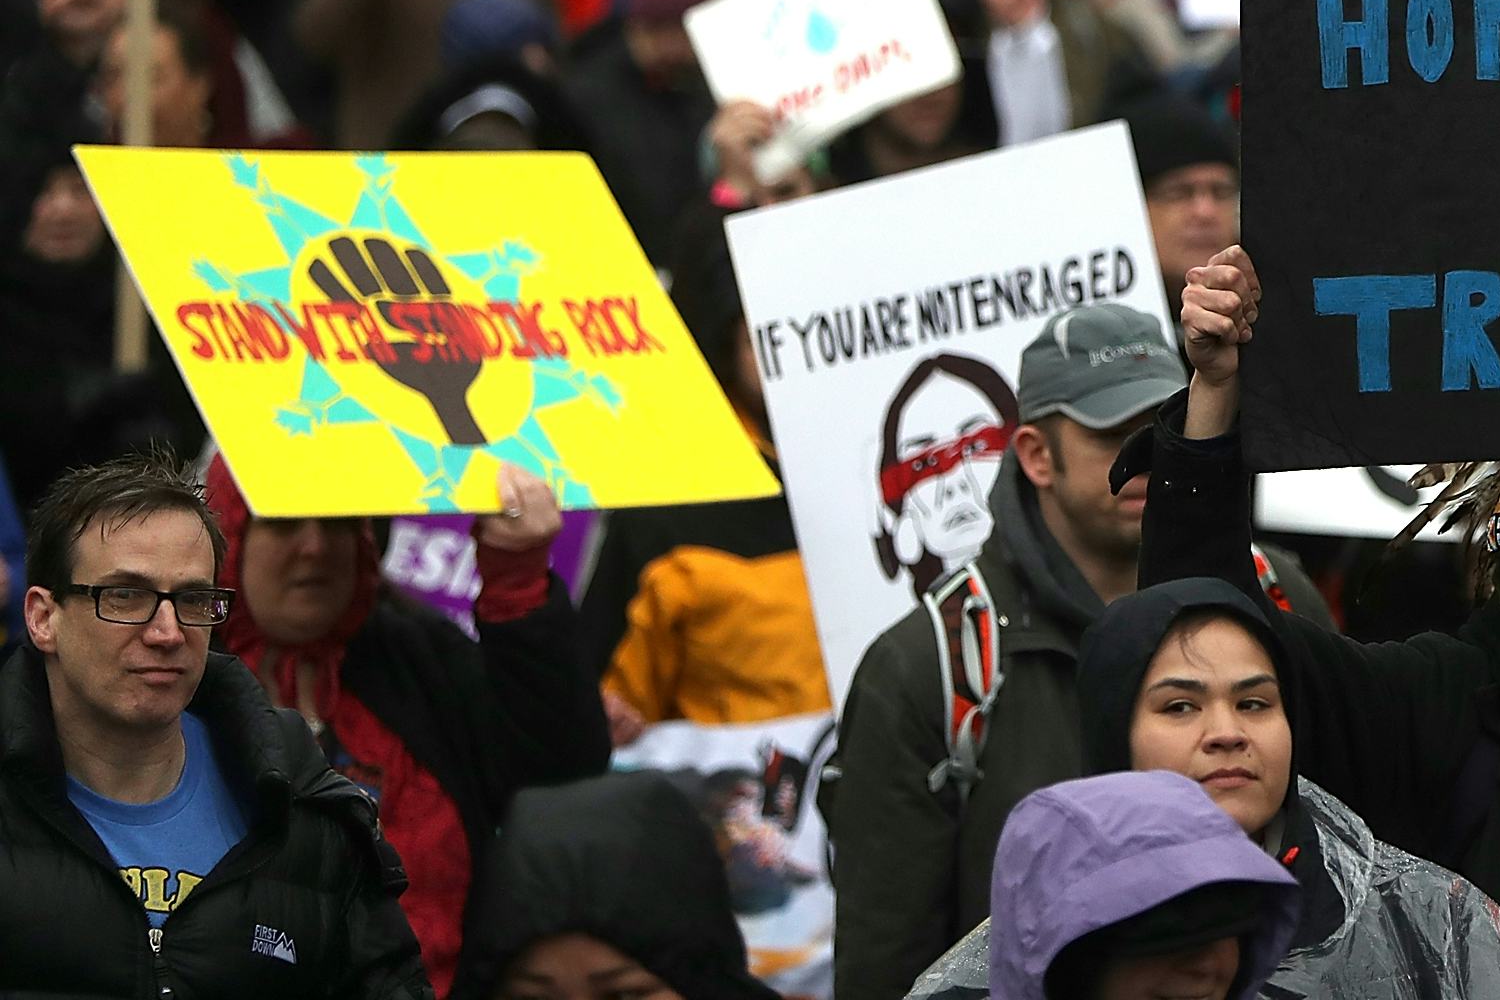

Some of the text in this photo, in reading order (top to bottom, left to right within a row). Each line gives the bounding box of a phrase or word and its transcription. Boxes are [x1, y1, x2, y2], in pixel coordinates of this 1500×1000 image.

[176, 296, 666, 363] STAND WITH STANDING ROCK
[756, 320, 786, 381] IF
[252, 939, 276, 958] DOWN
[255, 924, 279, 942] FIRST
